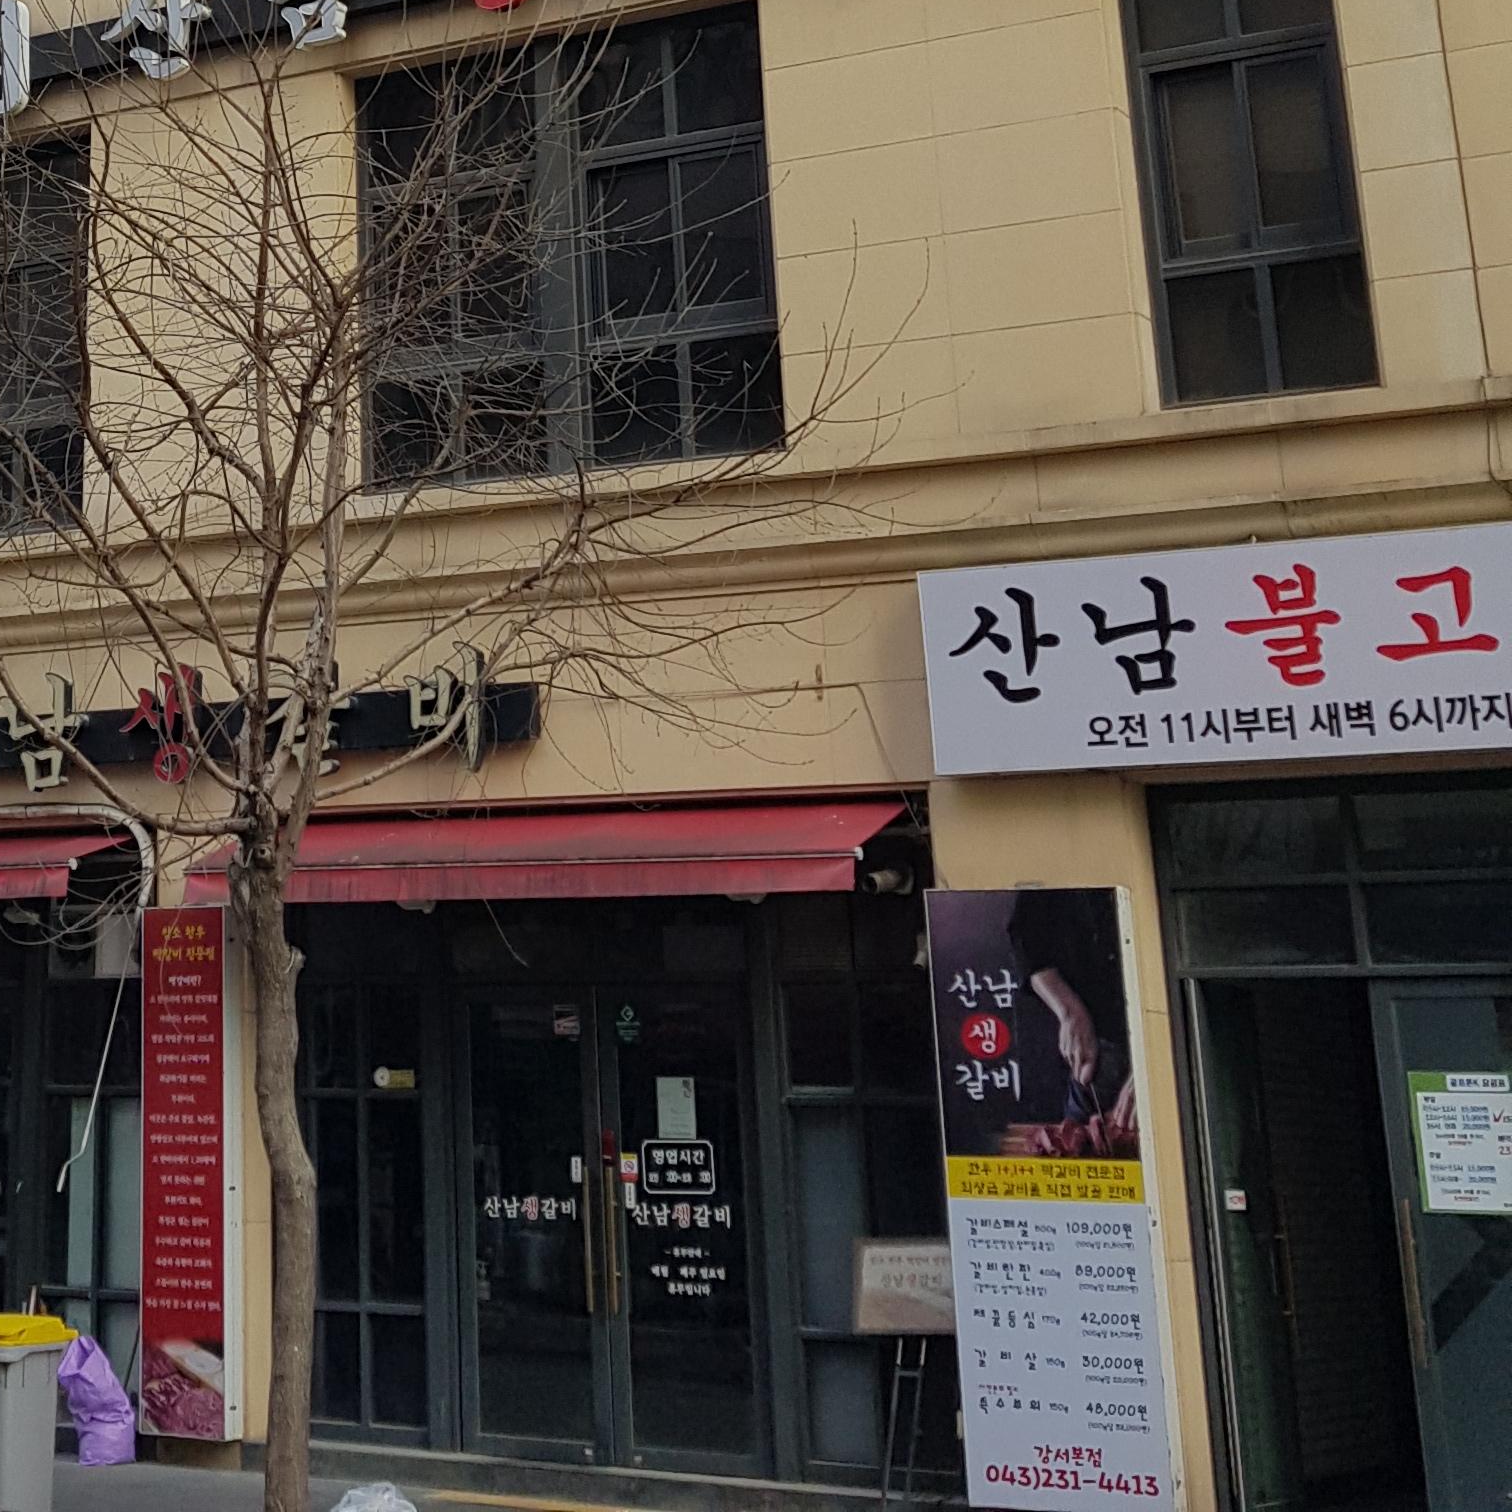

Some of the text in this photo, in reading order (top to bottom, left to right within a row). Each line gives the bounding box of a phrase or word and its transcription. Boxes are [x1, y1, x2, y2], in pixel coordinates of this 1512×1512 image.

[949, 576, 1196, 703] 산남
[1088, 691, 1512, 749] 오전 11시부터 새벽 6시까지
[948, 969, 1019, 1008] 산남
[969, 1019, 996, 1054] 생
[956, 1060, 1022, 1102] 갈비
[651, 1148, 706, 1166] 영업시간
[483, 1196, 577, 1223] 산남생갈비
[631, 1202, 732, 1230] 산남생갈비
[1034, 1444, 1103, 1469] 강서본점
[986, 1464, 1160, 1498] 043)231-4413
